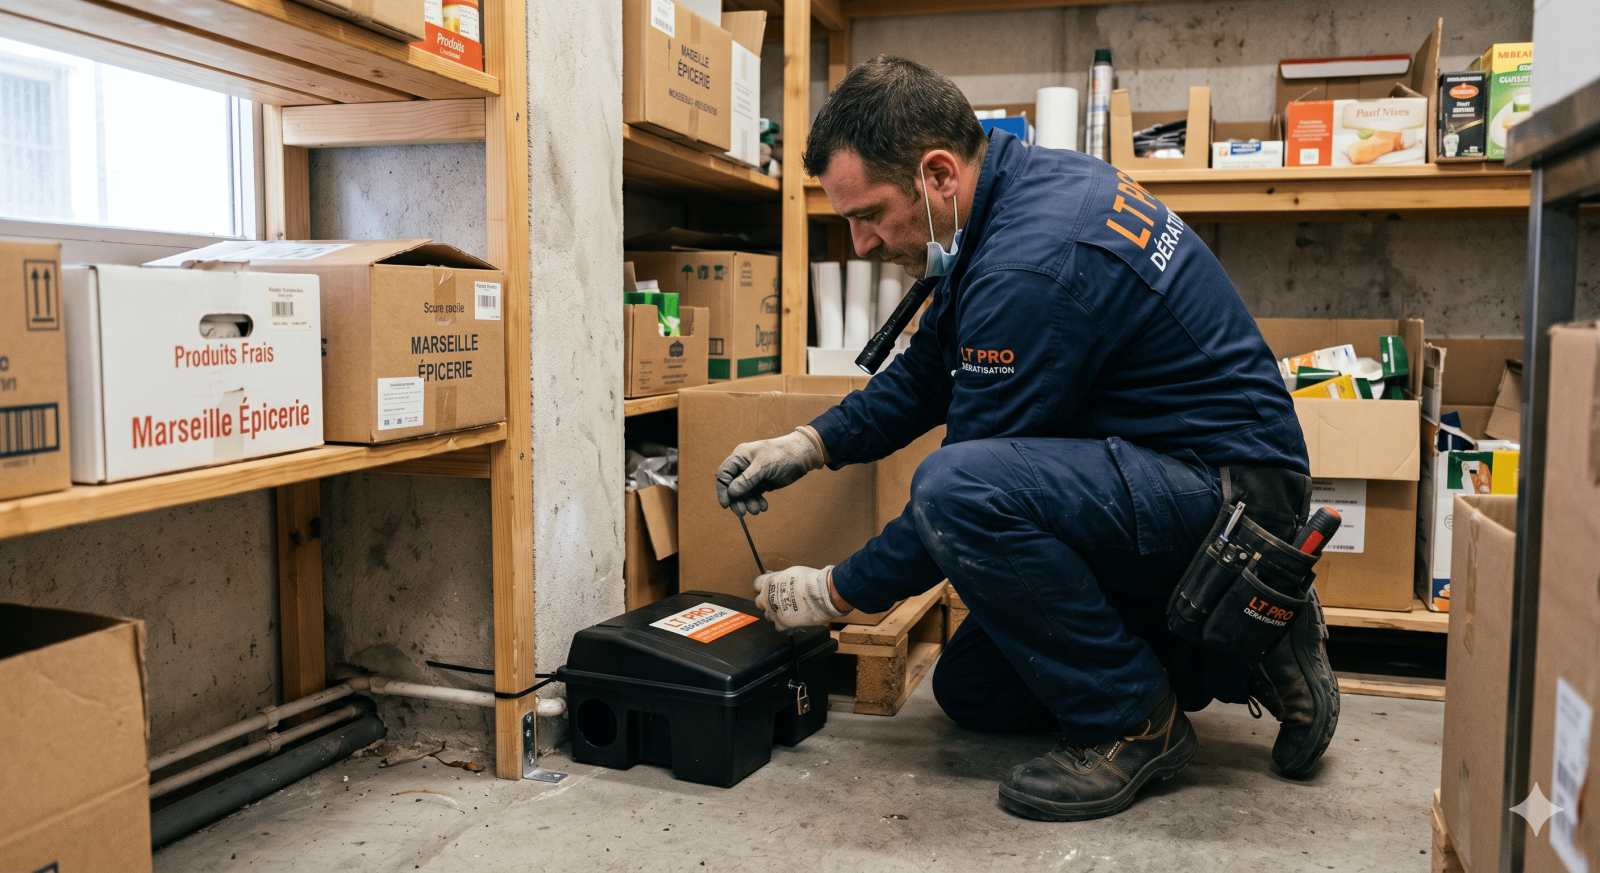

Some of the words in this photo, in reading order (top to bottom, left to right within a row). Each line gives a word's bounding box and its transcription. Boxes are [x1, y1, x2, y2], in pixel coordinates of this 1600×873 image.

[677, 58, 711, 90] ÉPICERIE
[1106, 194, 1155, 250] LT
[175, 344, 238, 368] Produits
[242, 342, 275, 364] Frais
[411, 334, 478, 355] MARSEILLE
[960, 346, 974, 362] LT
[976, 348, 1015, 364] PRO
[418, 359, 473, 382] ÉPICERIE
[132, 408, 232, 449] Marseille
[239, 397, 310, 439] Épicerie
[663, 618, 687, 628] LT
[681, 607, 715, 620] PRO
[1248, 596, 1269, 611] LT
[1266, 606, 1294, 621] PRO
